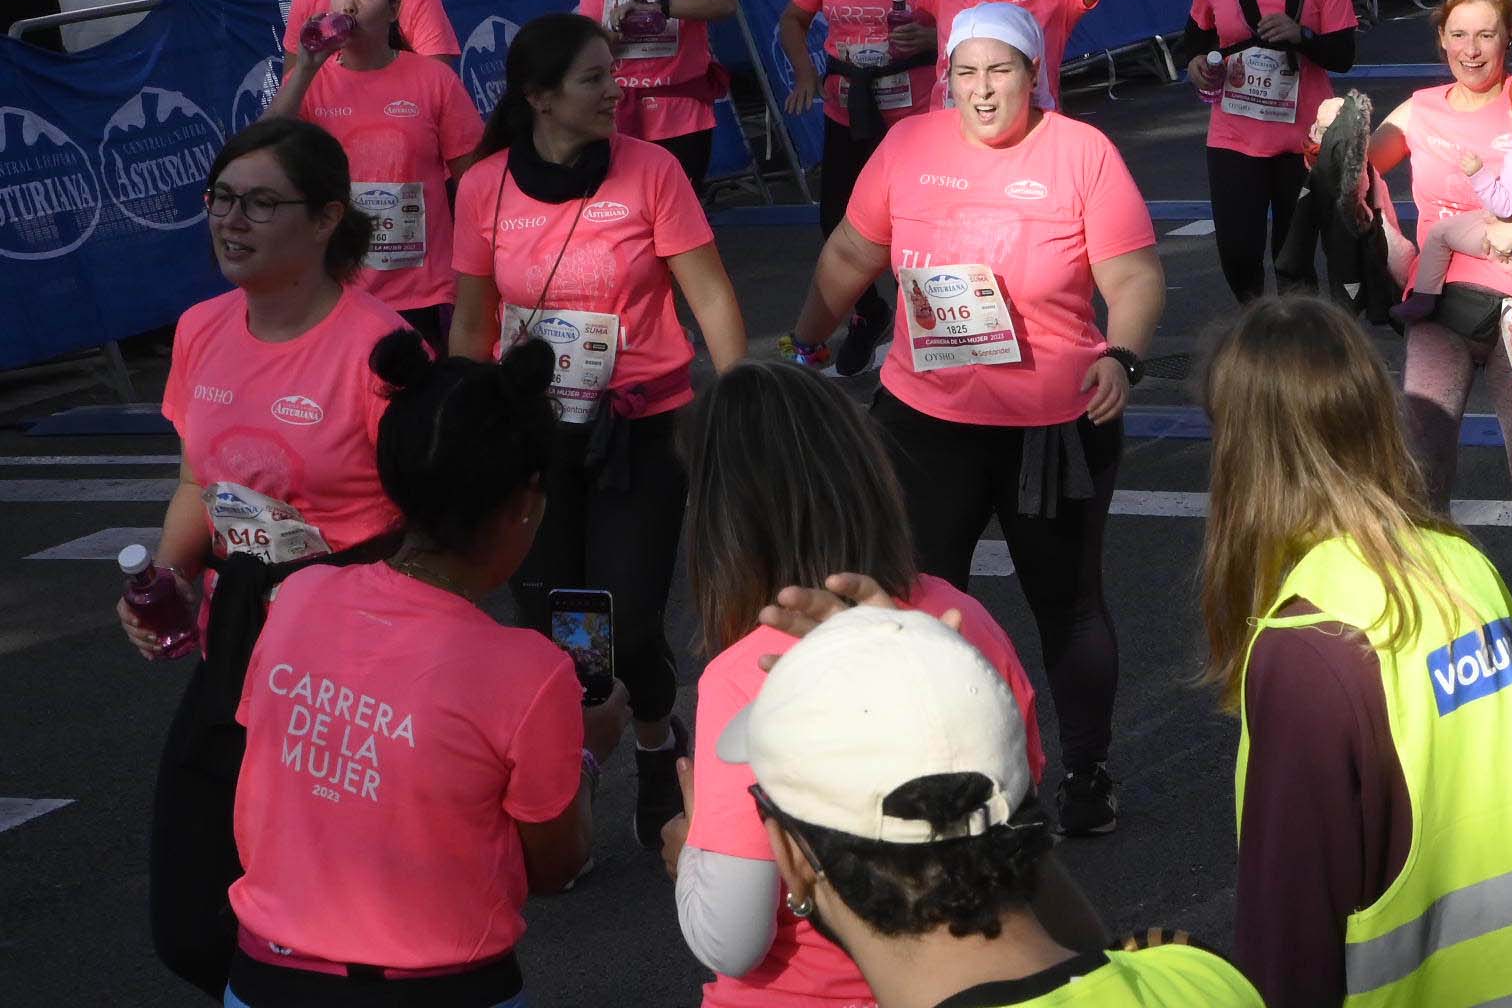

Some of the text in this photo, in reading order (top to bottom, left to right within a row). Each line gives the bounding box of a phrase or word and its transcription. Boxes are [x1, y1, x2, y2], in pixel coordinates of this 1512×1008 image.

[1247, 75, 1272, 88] 016
[920, 174, 968, 190] OYSHO
[586, 208, 628, 219] ASTURIANA
[500, 215, 546, 231] OYSHO
[936, 305, 971, 321] 016
[585, 327, 608, 335] SUMA
[946, 325, 968, 335] 1825
[925, 353, 955, 362] OYSHO
[193, 385, 233, 405] OYSHO
[275, 402, 320, 421] ASTURIANA
[227, 528, 271, 546] 016
[268, 663, 416, 749] CARRERA
[287, 705, 379, 767] DE LA
[281, 736, 382, 803] MUJER
[312, 784, 342, 803] 2023
